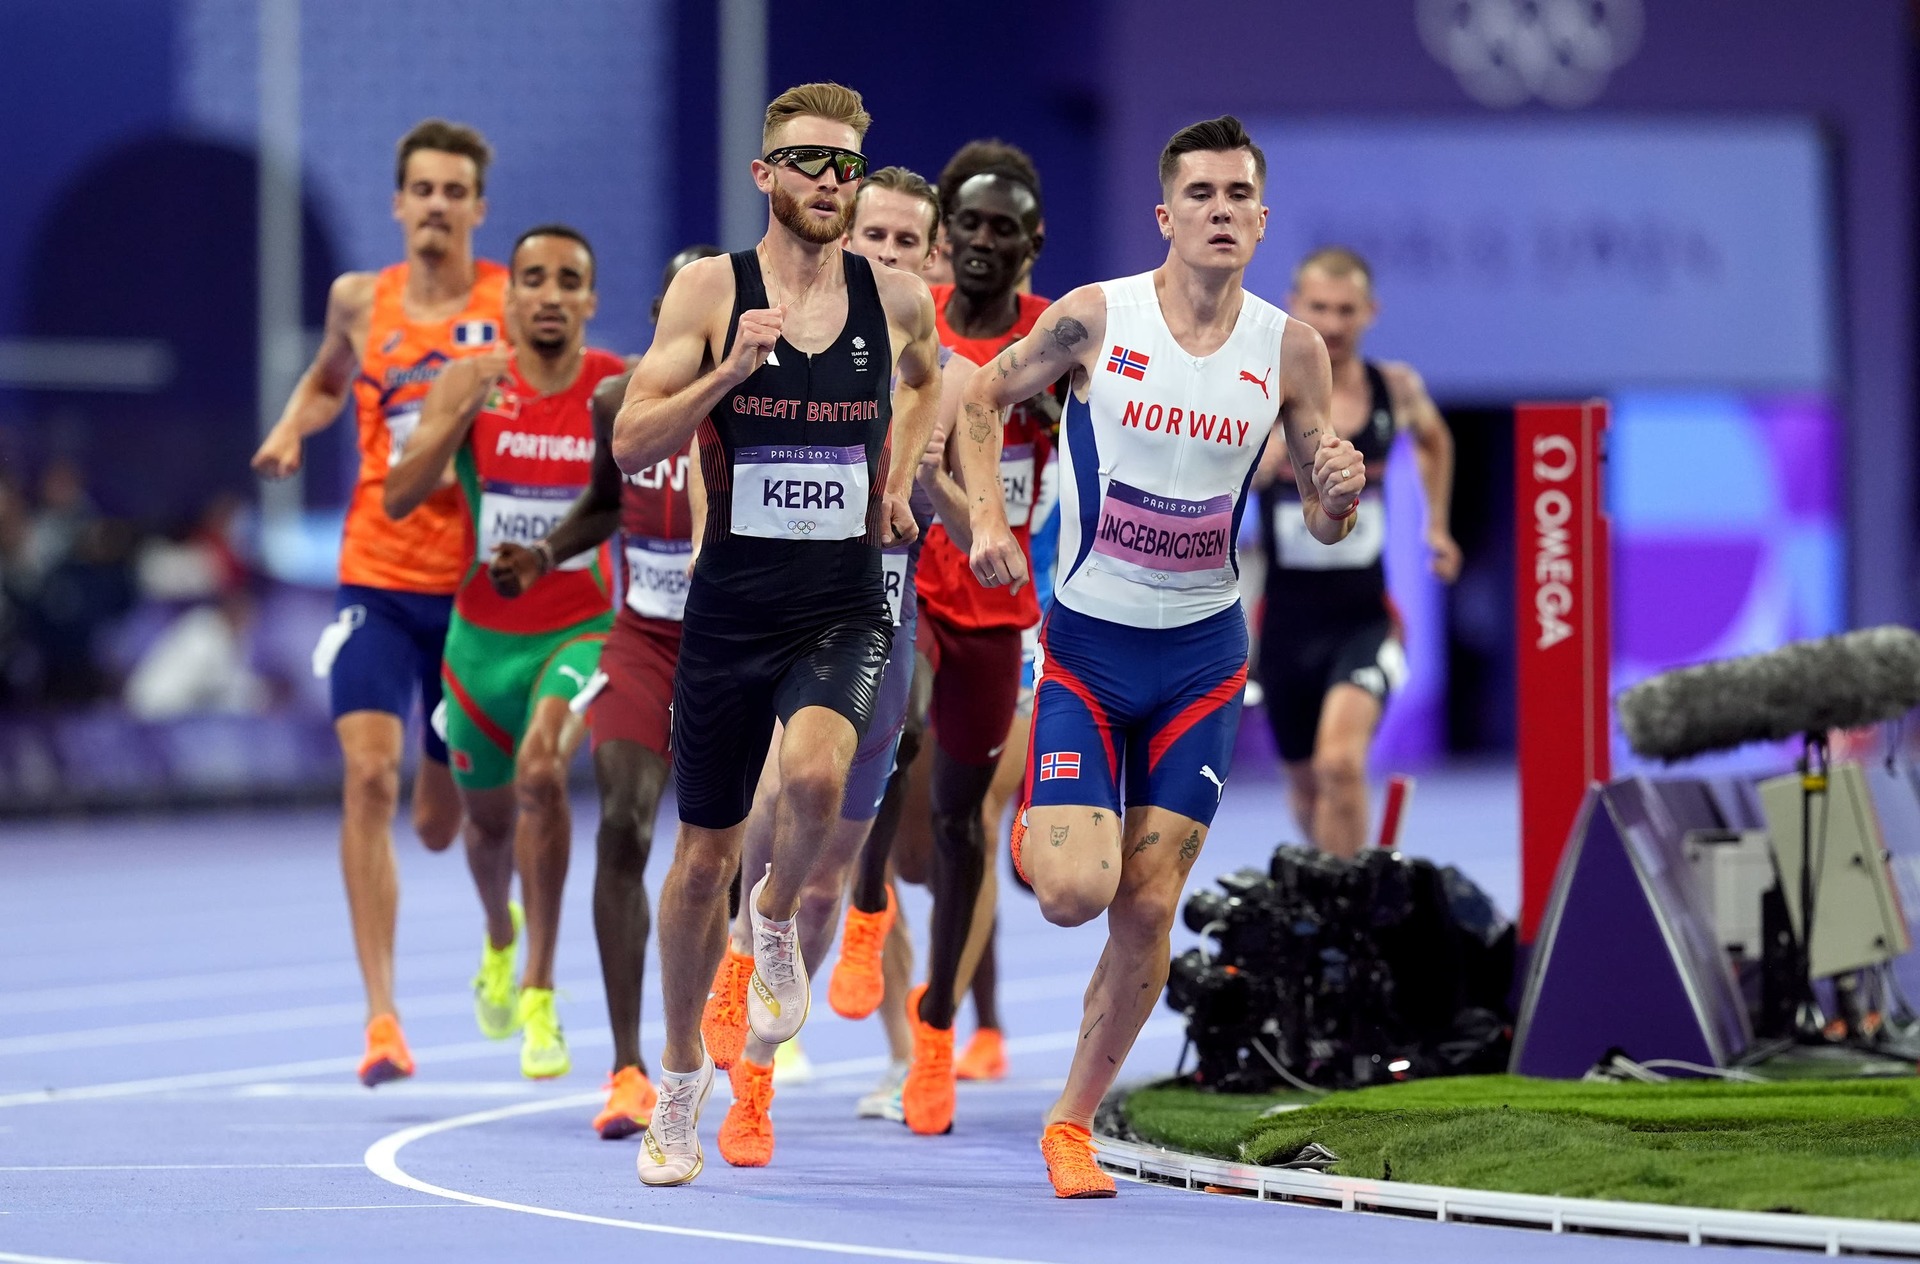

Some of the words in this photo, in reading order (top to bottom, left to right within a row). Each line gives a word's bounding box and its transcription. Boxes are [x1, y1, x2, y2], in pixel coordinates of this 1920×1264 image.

[732, 395, 801, 420] GREAT
[806, 399, 879, 422] BRITAIN
[1121, 400, 1250, 447] NORWAY
[771, 450, 805, 459] PARIS
[808, 450, 838, 460] 2024
[763, 478, 845, 510] KERR
[1142, 496, 1177, 512] PARIS
[1100, 513, 1227, 559] INGEBRIGTSEN
[1533, 489, 1574, 651] OMEGA
